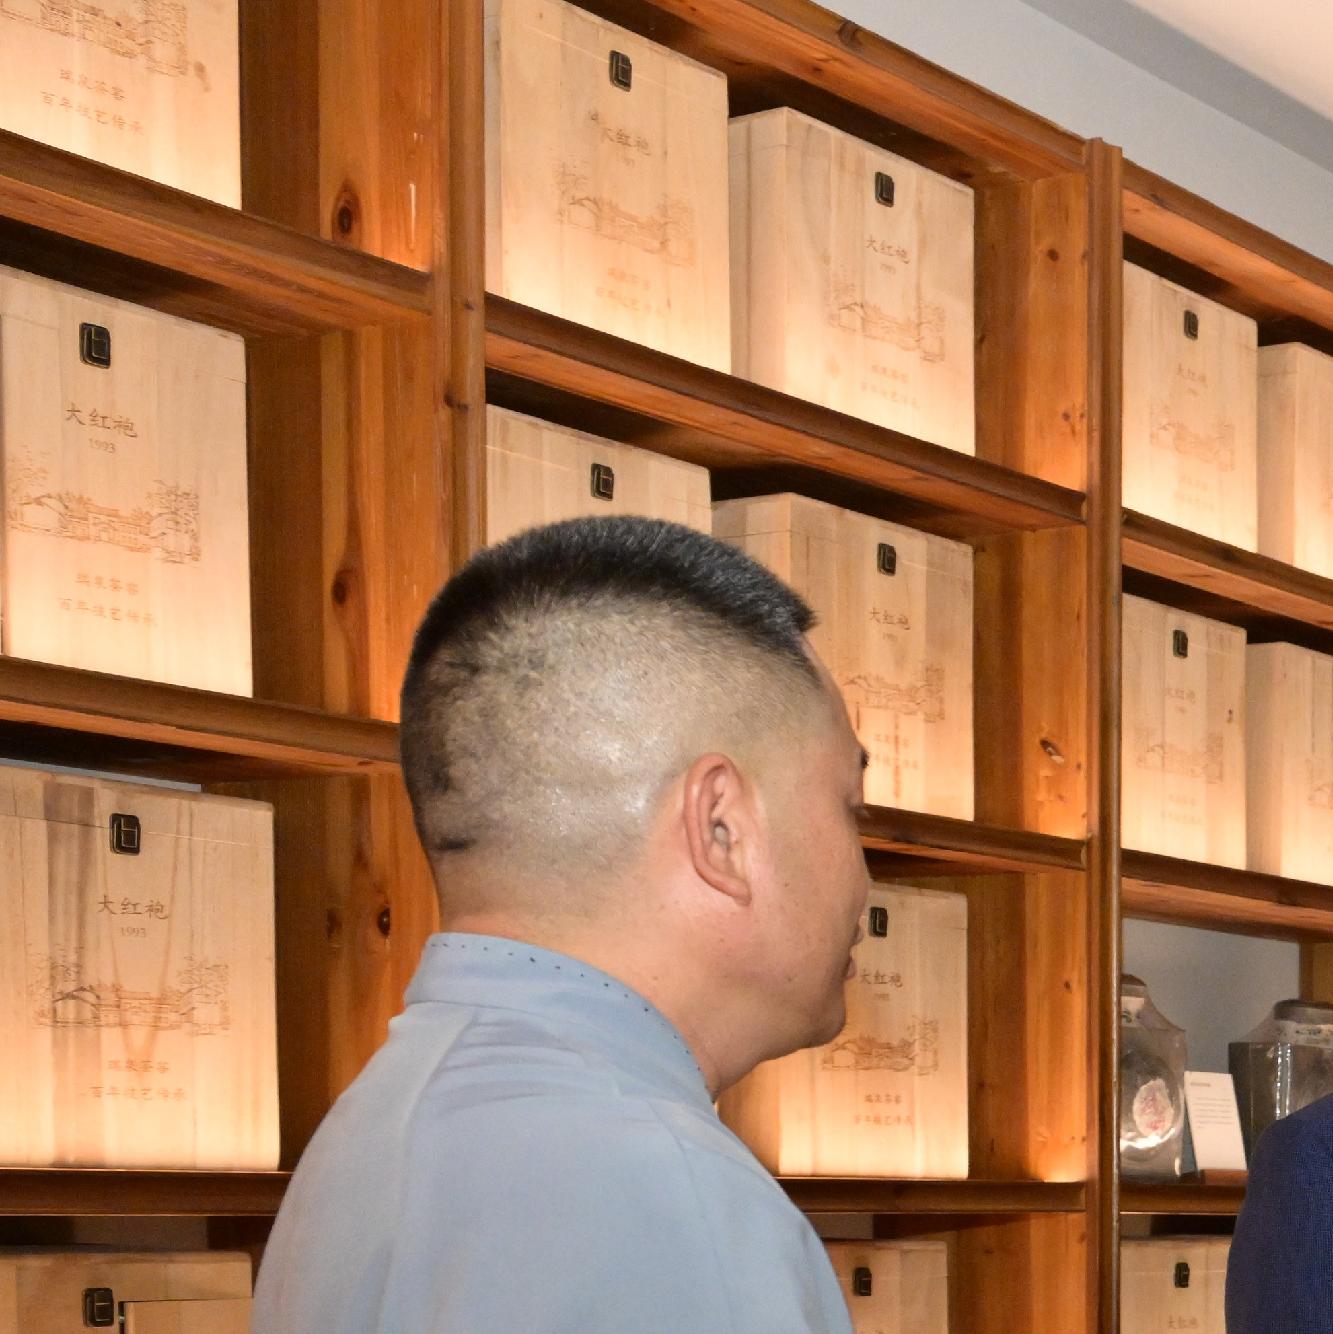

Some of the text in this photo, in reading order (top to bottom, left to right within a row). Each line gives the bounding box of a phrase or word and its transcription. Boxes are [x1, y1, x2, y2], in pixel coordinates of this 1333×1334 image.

[863, 233, 910, 264] 大红袍
[65, 402, 138, 438] 大红袍
[88, 437, 115, 454] 1993
[868, 607, 911, 631] 大红袍
[98, 894, 169, 920] 大红袍
[860, 968, 903, 988] 大红袍
